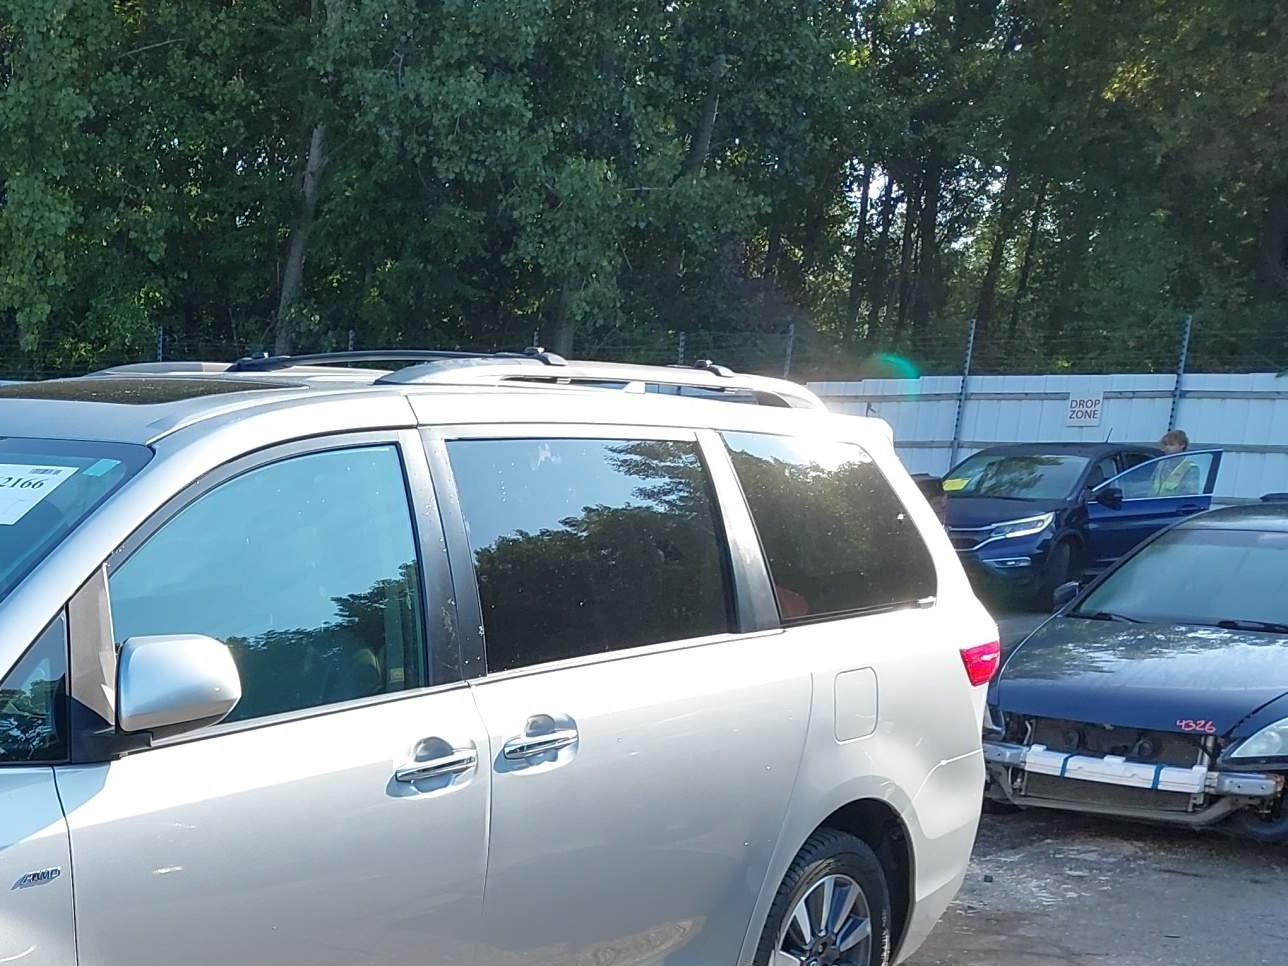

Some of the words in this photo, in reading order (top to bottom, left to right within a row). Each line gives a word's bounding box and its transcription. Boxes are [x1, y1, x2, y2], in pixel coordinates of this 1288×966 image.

[1070, 399, 1101, 409] DROP
[1069, 409, 1099, 419] ZONE
[1176, 719, 1216, 733] 4326
